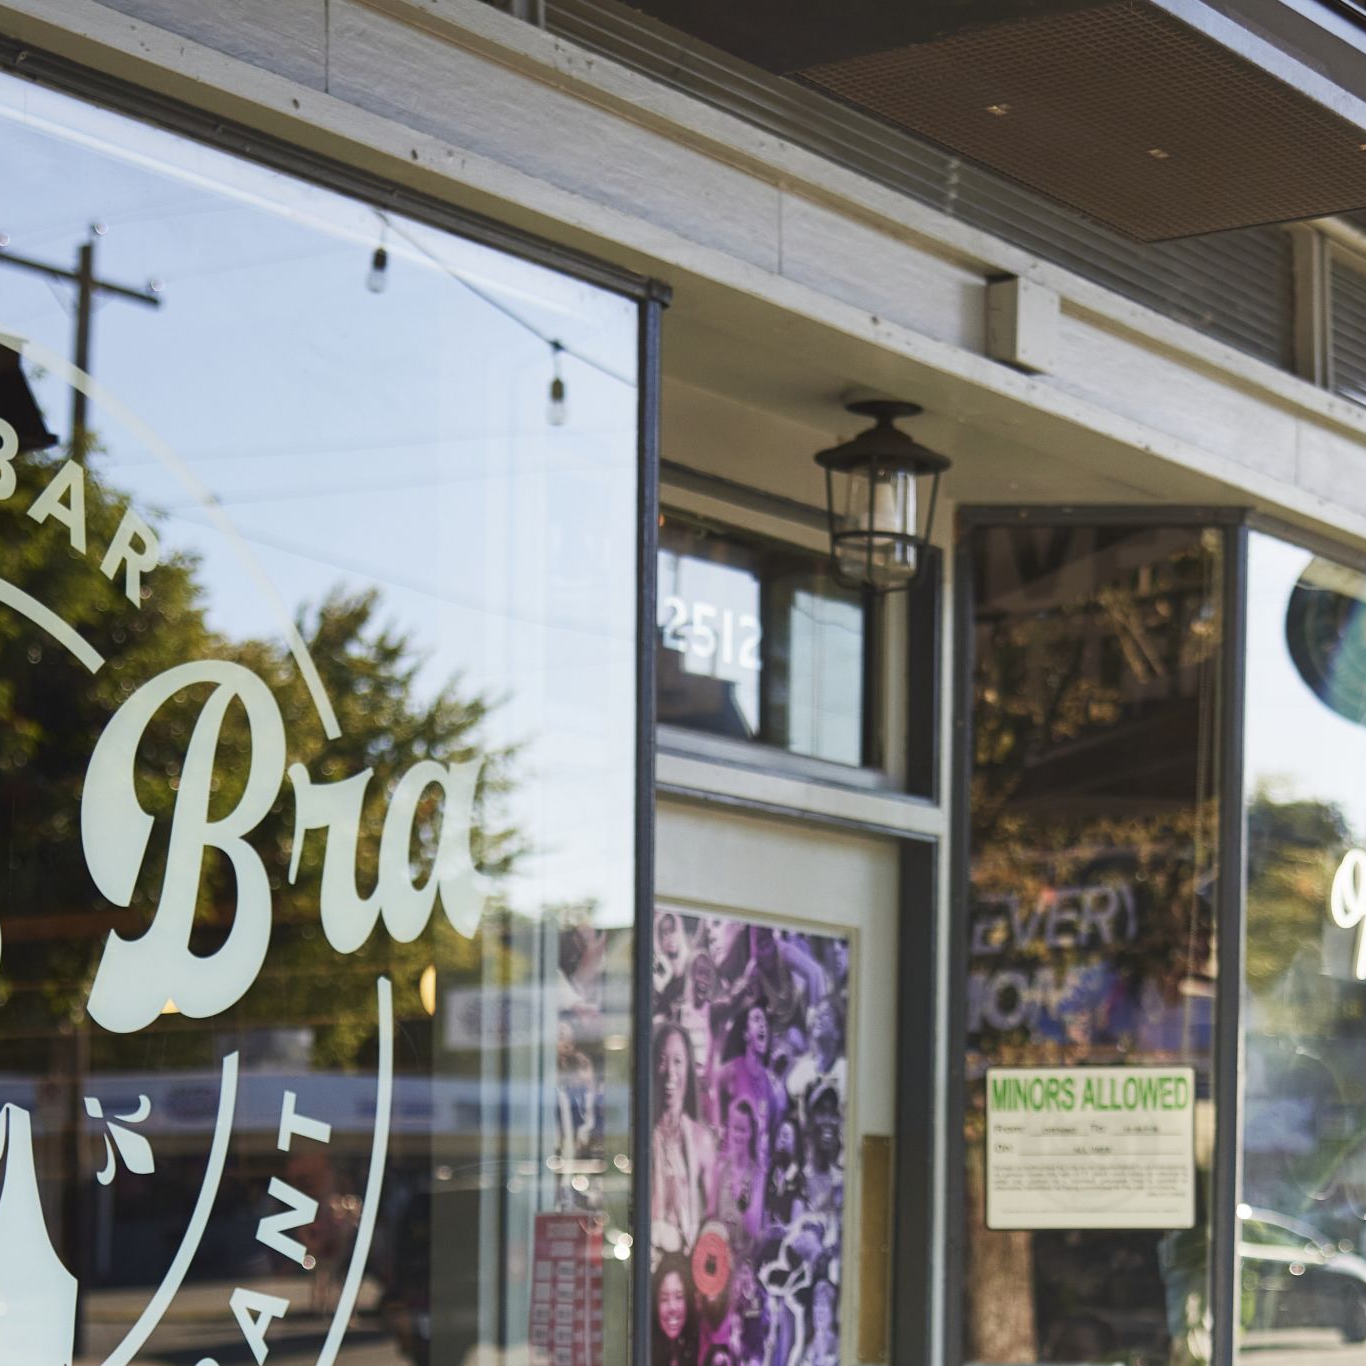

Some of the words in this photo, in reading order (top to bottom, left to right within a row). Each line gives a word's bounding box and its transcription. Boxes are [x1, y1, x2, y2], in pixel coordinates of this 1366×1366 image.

[662, 597, 763, 671] 2512
[81, 659, 489, 1033] Bra
[992, 1077, 1075, 1112] MINORS
[1082, 1077, 1189, 1111] ALLOWED
